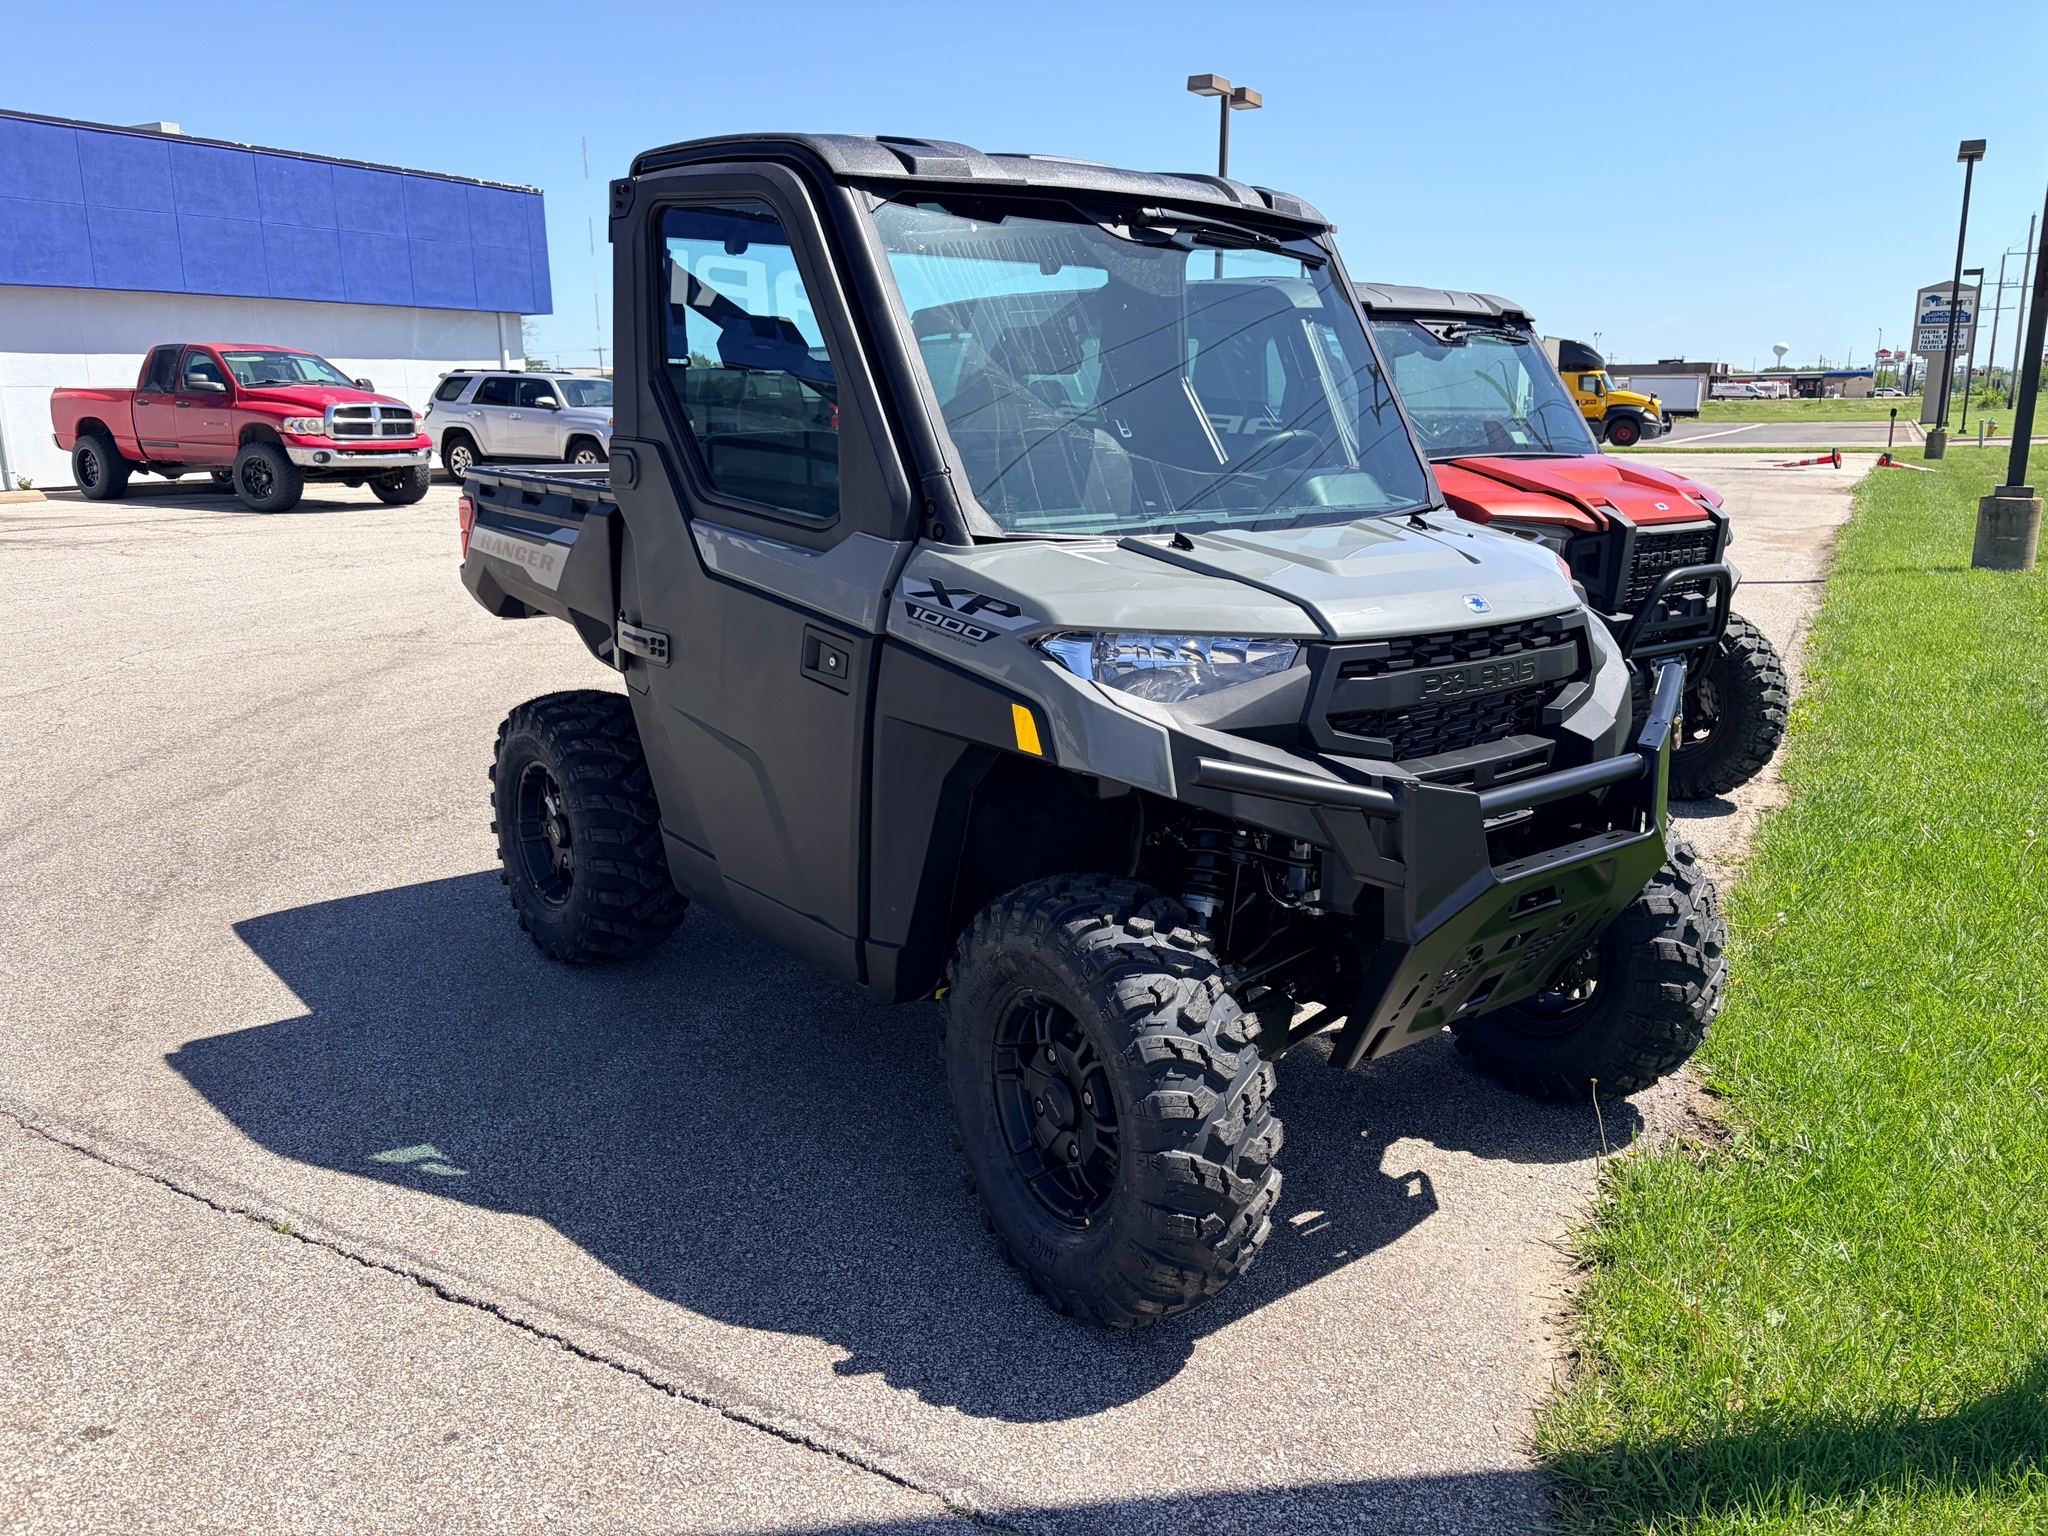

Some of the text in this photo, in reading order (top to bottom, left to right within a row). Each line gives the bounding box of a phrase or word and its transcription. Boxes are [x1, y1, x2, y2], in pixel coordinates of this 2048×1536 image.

[480, 533, 555, 572] RANGER
[1638, 546, 1708, 569] POLARIS
[906, 576, 1022, 618] XP
[907, 620, 978, 648] DUAL OVERHEAD CAM
[912, 607, 988, 641] 1000
[1420, 658, 1536, 699] POLARIS
